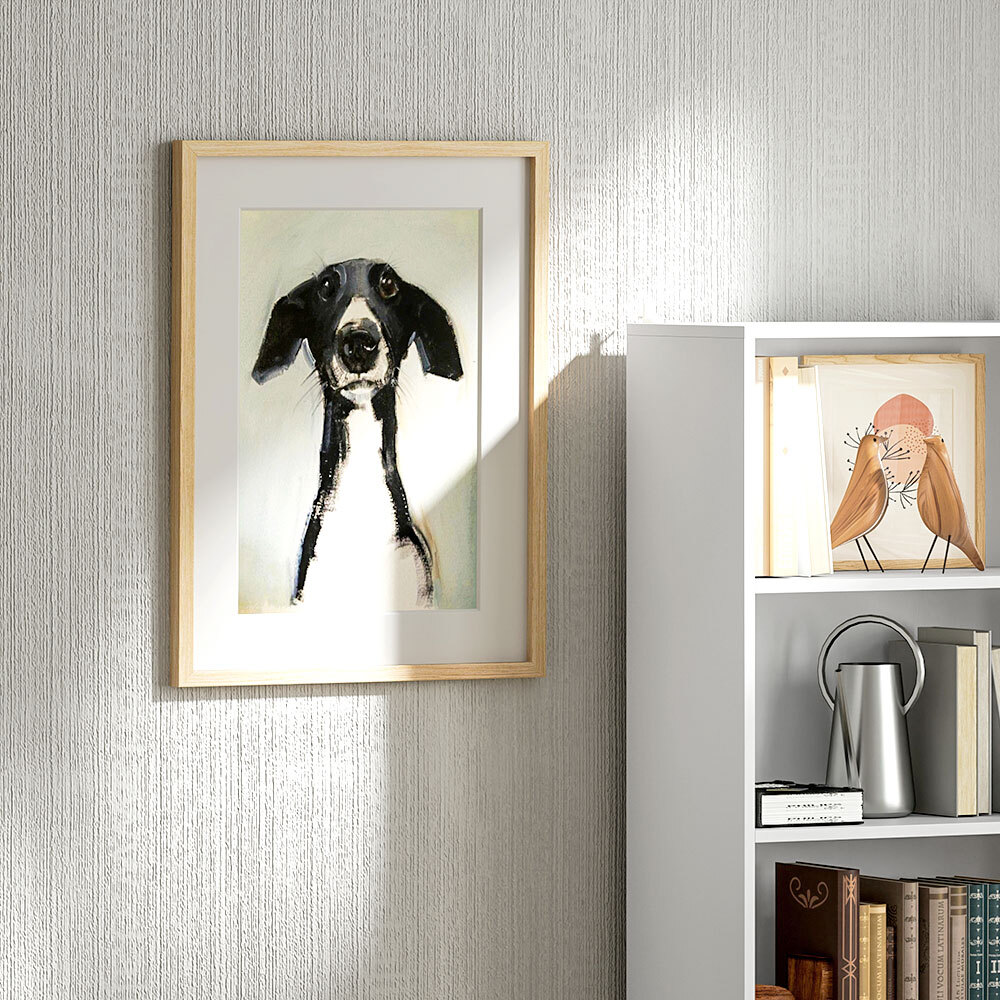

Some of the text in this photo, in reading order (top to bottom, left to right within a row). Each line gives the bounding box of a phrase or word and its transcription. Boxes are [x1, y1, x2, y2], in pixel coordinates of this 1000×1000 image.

[936, 901, 944, 952] LATINARUM
[936, 955, 944, 988] VOCUM
[976, 960, 980, 974] I
[990, 960, 1000, 973] II
